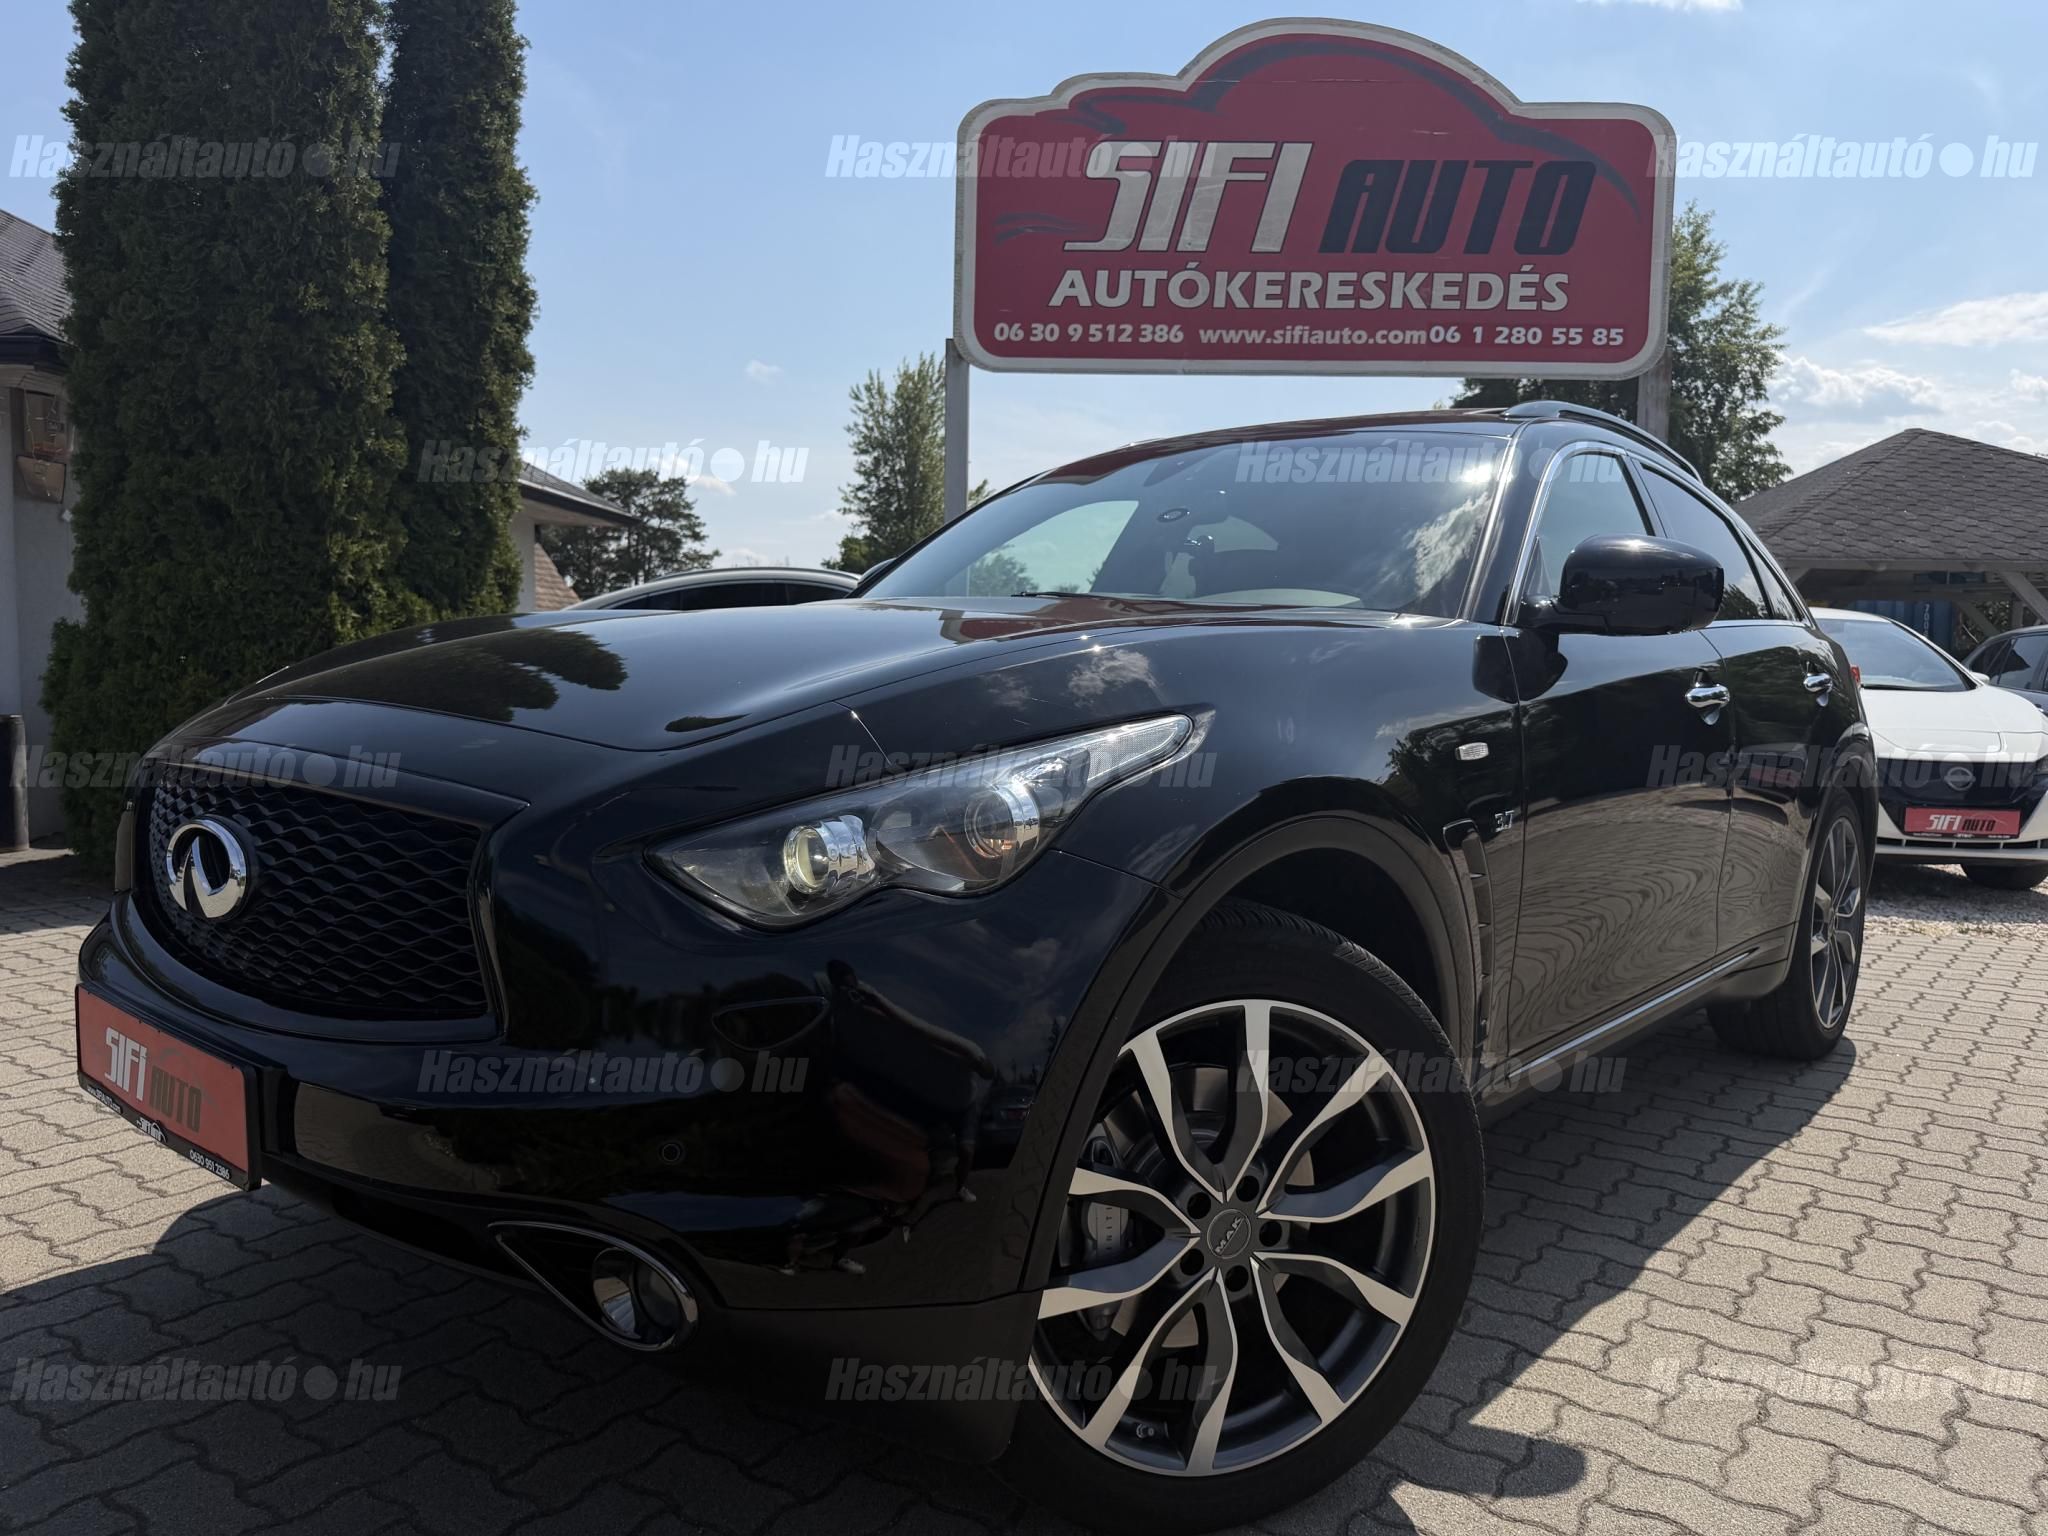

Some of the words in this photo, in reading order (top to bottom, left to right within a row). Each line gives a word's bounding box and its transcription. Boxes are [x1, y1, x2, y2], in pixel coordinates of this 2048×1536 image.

[1063, 141, 1313, 253] SIFI
[1319, 159, 1597, 255] AUTO
[1047, 262, 1569, 312] AUTÓKERESKEDÉS
[993, 322, 1024, 342] 06
[1029, 323, 1060, 342] 30
[1139, 324, 1184, 343] 386
[1199, 326, 1426, 345] www.sifiauto.com
[1429, 325, 1461, 344] 06
[1472, 326, 1483, 343] 1
[1494, 326, 1542, 344] 280
[1552, 328, 1583, 345] 55
[1592, 328, 1624, 345] 85
[1926, 814, 1961, 831] SIFI
[1962, 818, 1996, 832] AUTO
[105, 1026, 147, 1101] SIFI
[152, 1065, 202, 1133] AUTO
